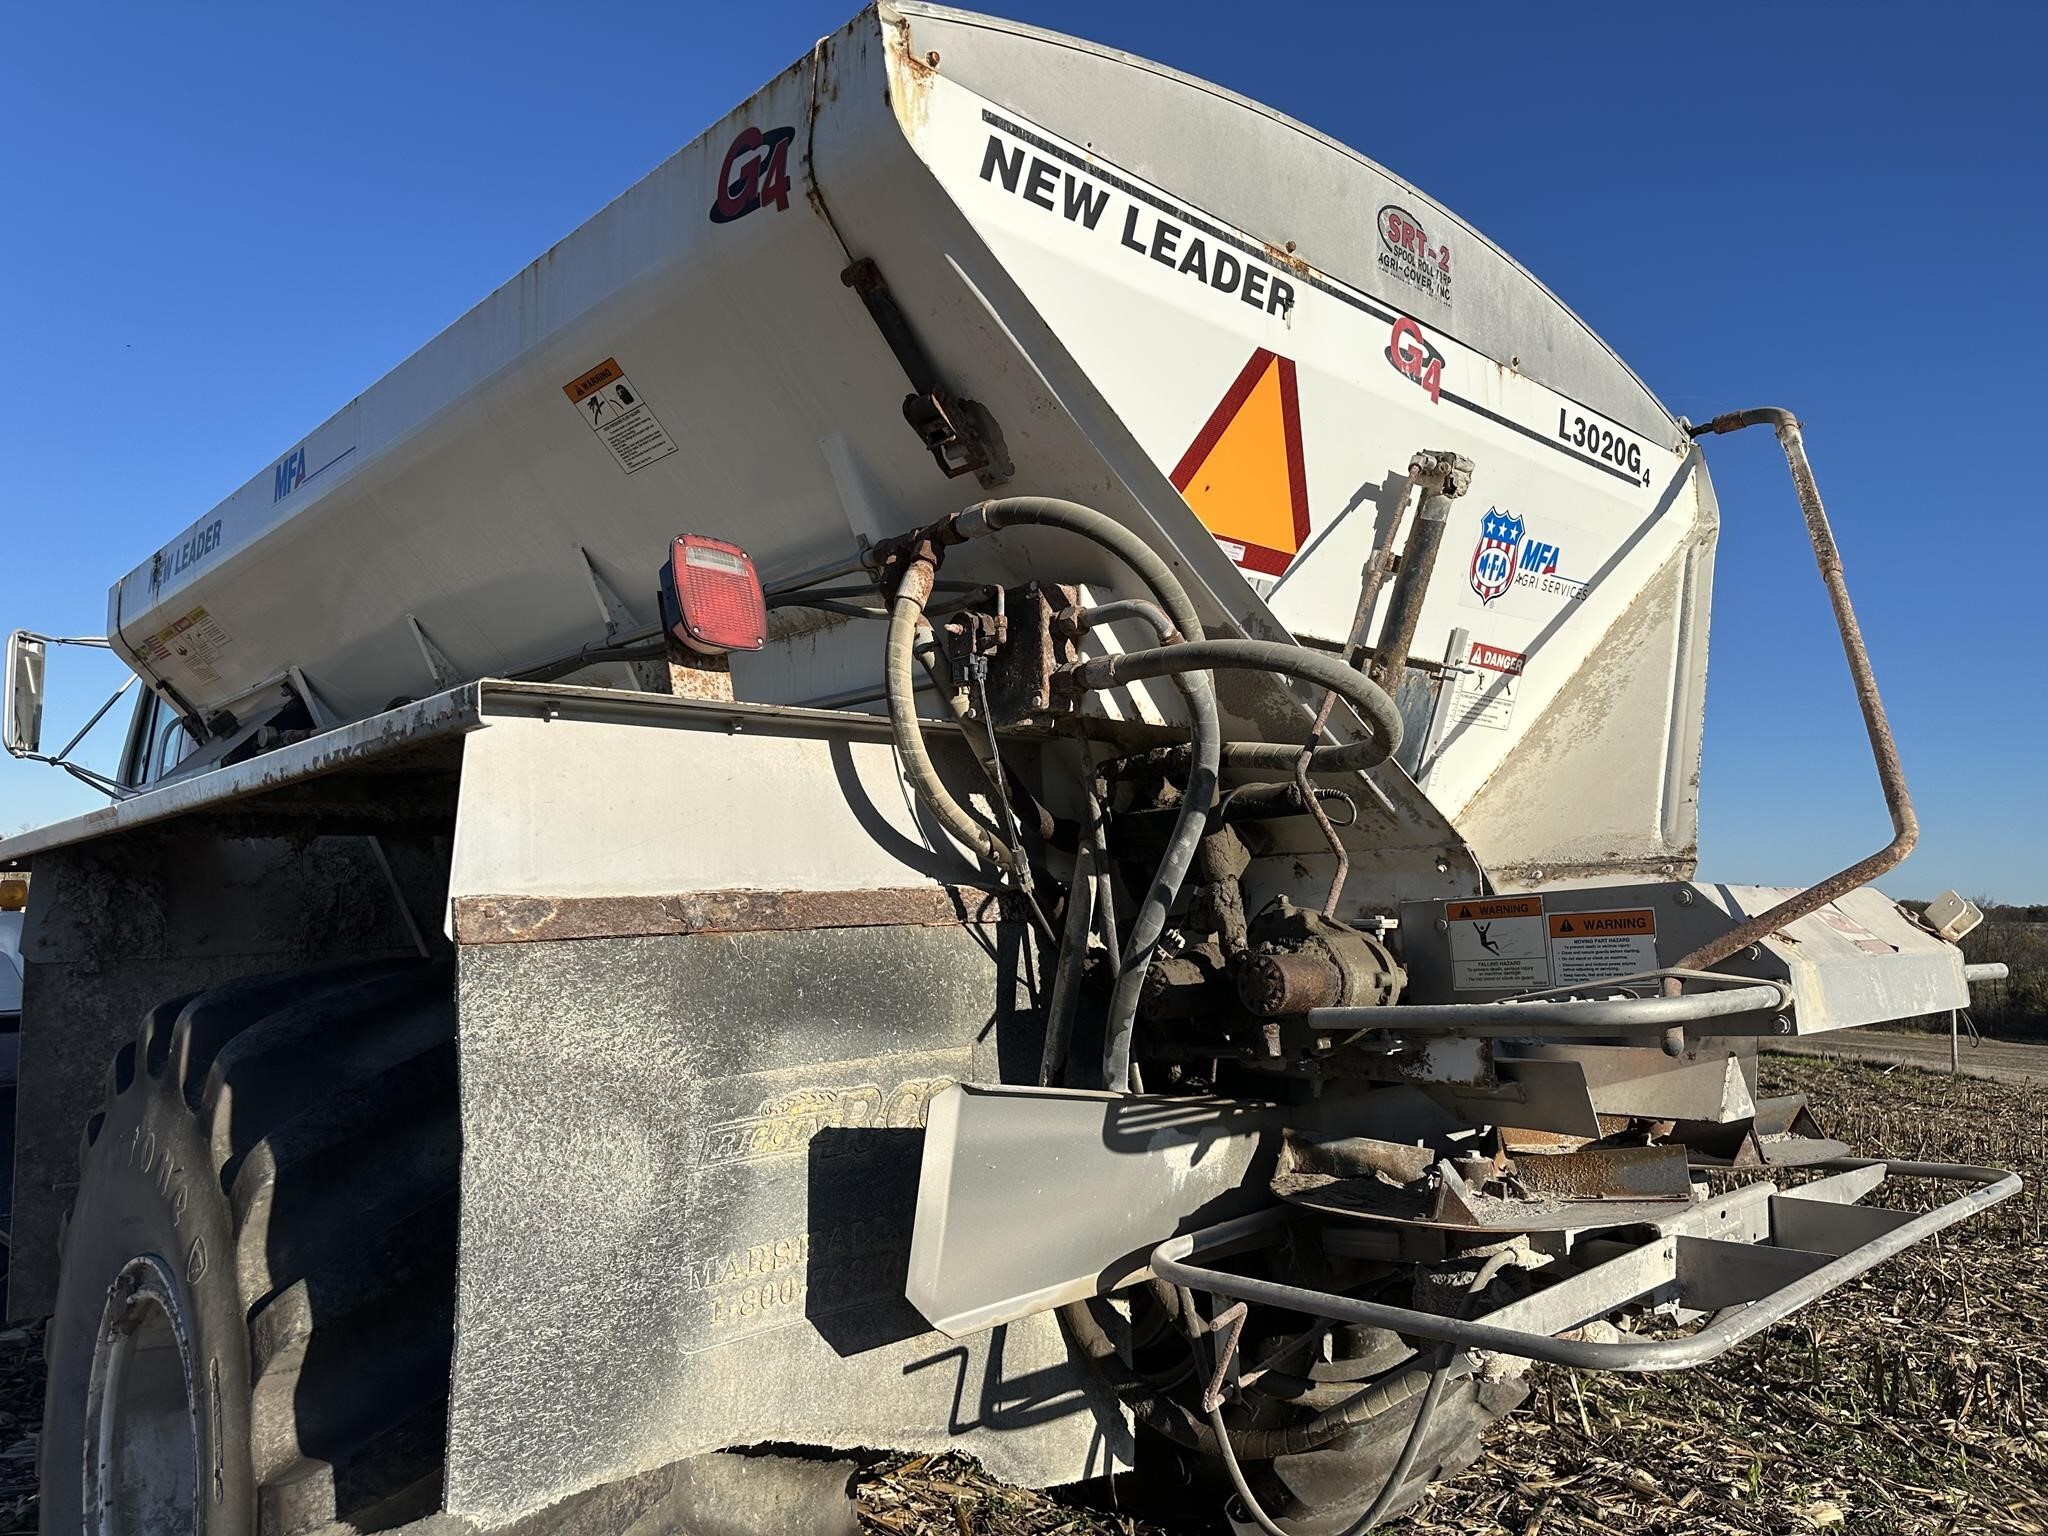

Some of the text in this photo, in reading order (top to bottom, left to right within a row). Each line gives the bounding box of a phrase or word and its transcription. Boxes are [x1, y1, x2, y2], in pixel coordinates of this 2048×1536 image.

[979, 135, 1110, 231] NEW
[1121, 204, 1296, 321] LEADER
[1387, 213, 1450, 273] SRT-2
[1393, 245, 1416, 267] SPOOL
[1418, 259, 1434, 278] ROLL
[273, 446, 306, 503] MFA
[174, 519, 222, 577] LEADER
[1519, 539, 1560, 575] MFA
[1514, 573, 1589, 601] AGRI SERVICES
[1483, 651, 1524, 672] DANGER
[1479, 903, 1529, 916] WARNING
[1583, 917, 1647, 931] WARNING
